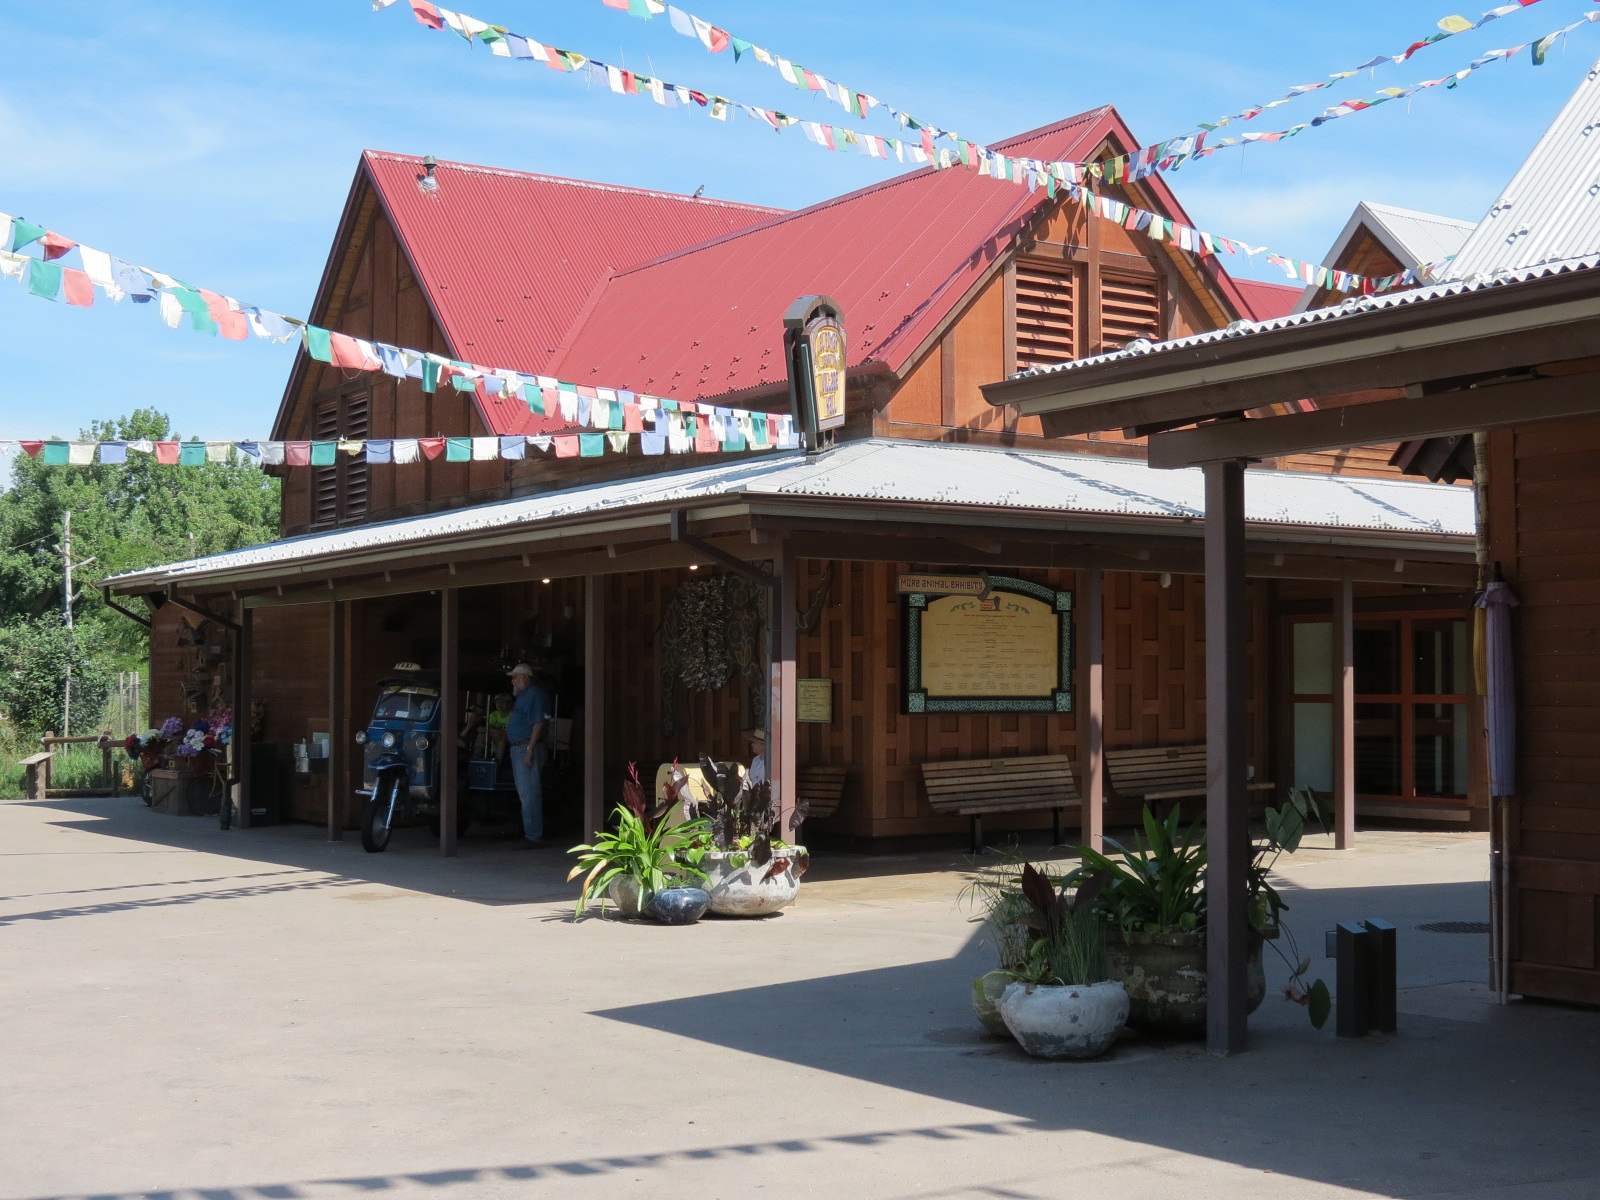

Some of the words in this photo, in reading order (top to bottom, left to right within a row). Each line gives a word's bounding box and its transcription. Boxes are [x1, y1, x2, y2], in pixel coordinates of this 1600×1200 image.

[900, 578, 920, 588] MORE
[922, 579, 948, 589] ANIMAL
[951, 581, 983, 590] EXHIBITS
